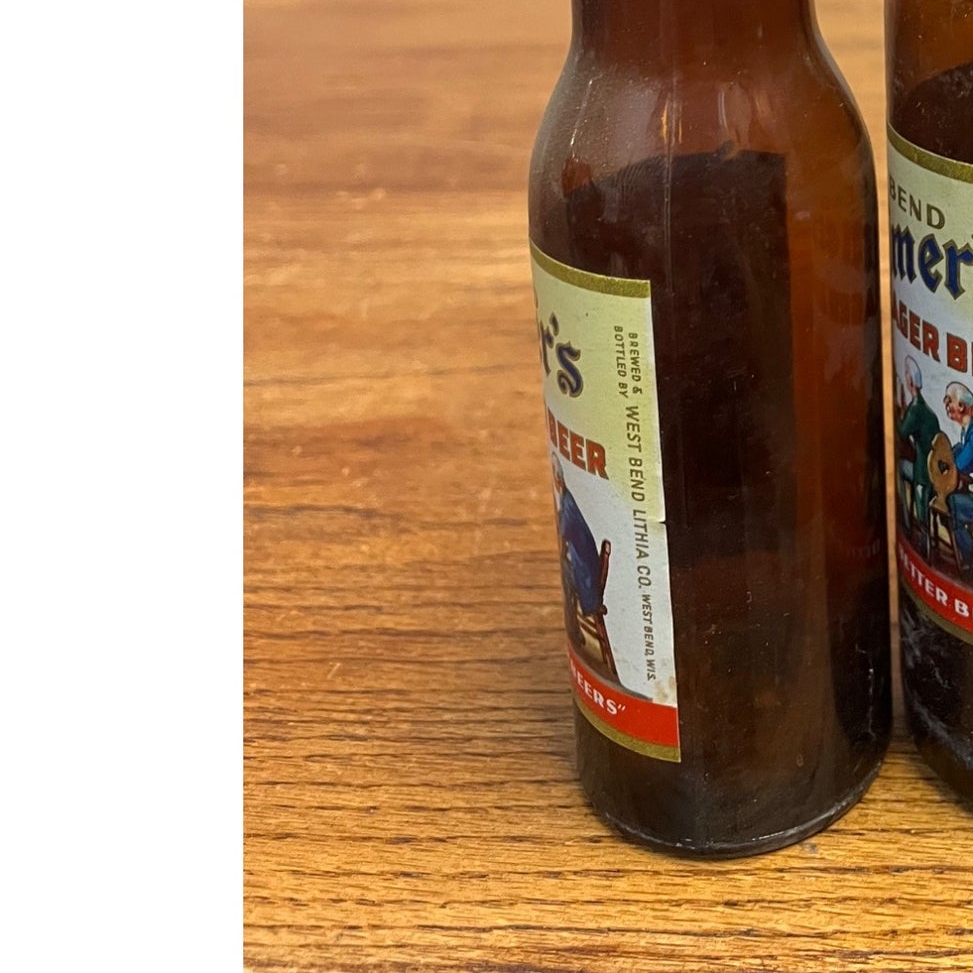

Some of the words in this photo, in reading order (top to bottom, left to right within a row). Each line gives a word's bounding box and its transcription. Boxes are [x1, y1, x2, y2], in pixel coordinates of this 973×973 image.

[890, 176, 945, 230] BEND
[614, 325, 627, 378] BOTTLED
[628, 332, 642, 382] BREWED
[618, 382, 629, 398] BY
[632, 386, 643, 395] &
[547, 406, 610, 480] BEER
[625, 405, 642, 453] WEST
[629, 456, 645, 502] BEND
[633, 509, 649, 560] LITHIA
[637, 565, 652, 589] CO.
[642, 594, 653, 624] WEST
